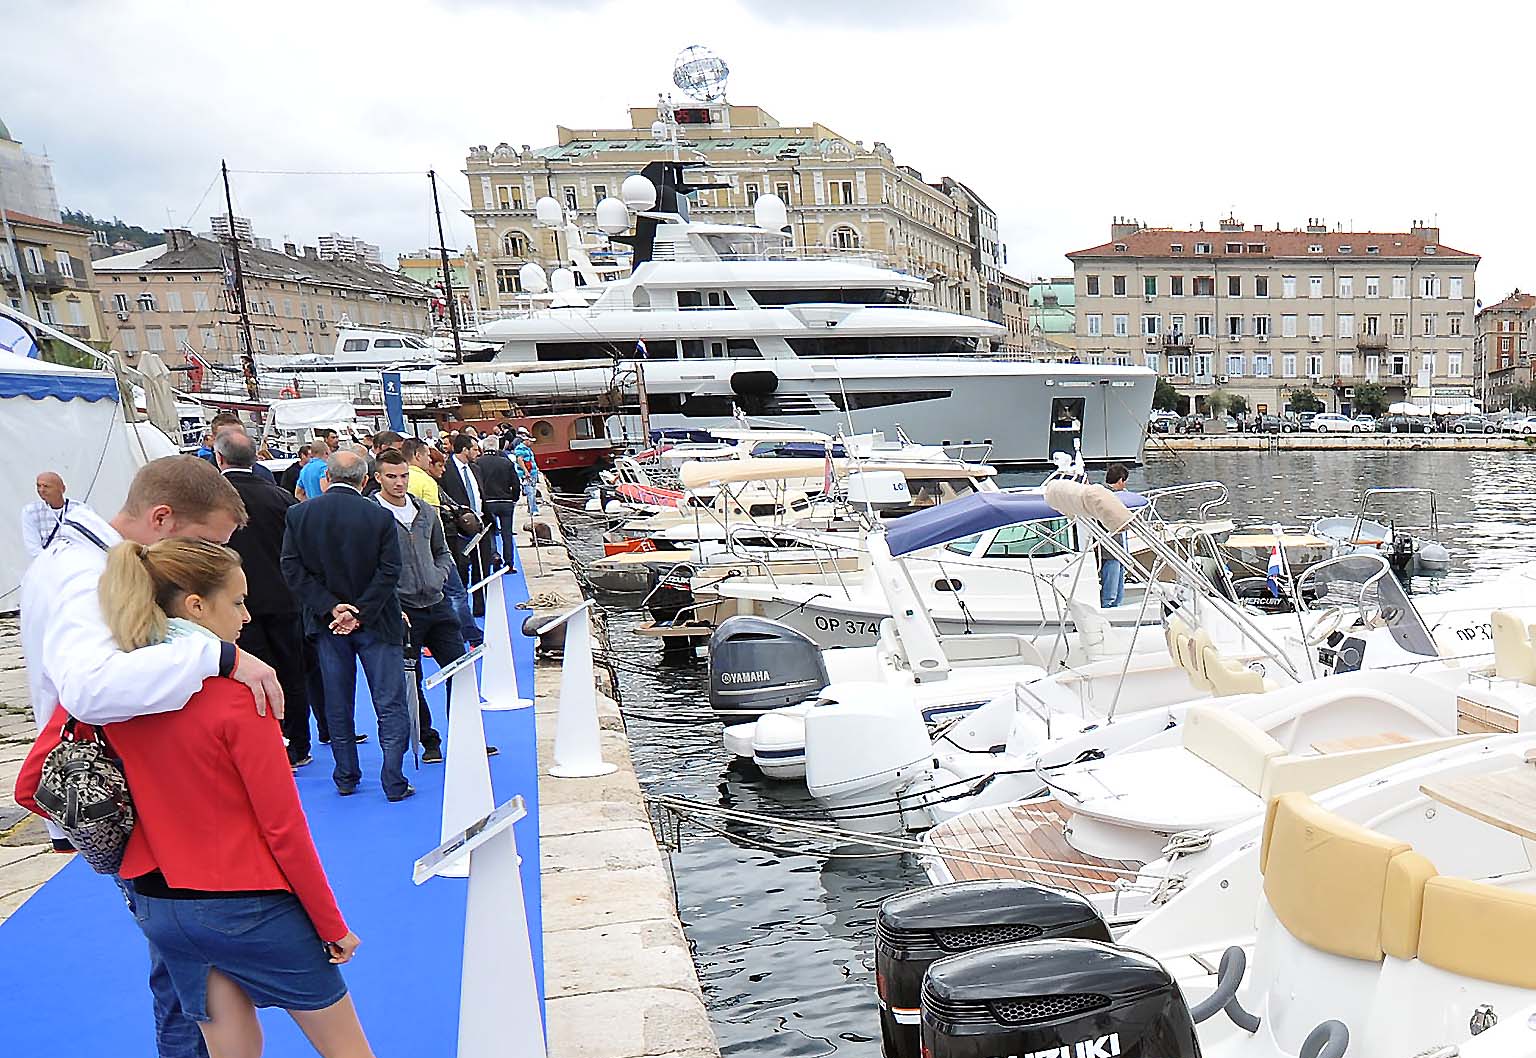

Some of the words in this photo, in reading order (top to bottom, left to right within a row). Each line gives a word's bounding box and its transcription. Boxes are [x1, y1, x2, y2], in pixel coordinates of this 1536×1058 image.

[815, 615, 840, 632] OP
[846, 620, 881, 637] 374
[731, 671, 771, 684] YAMAHA
